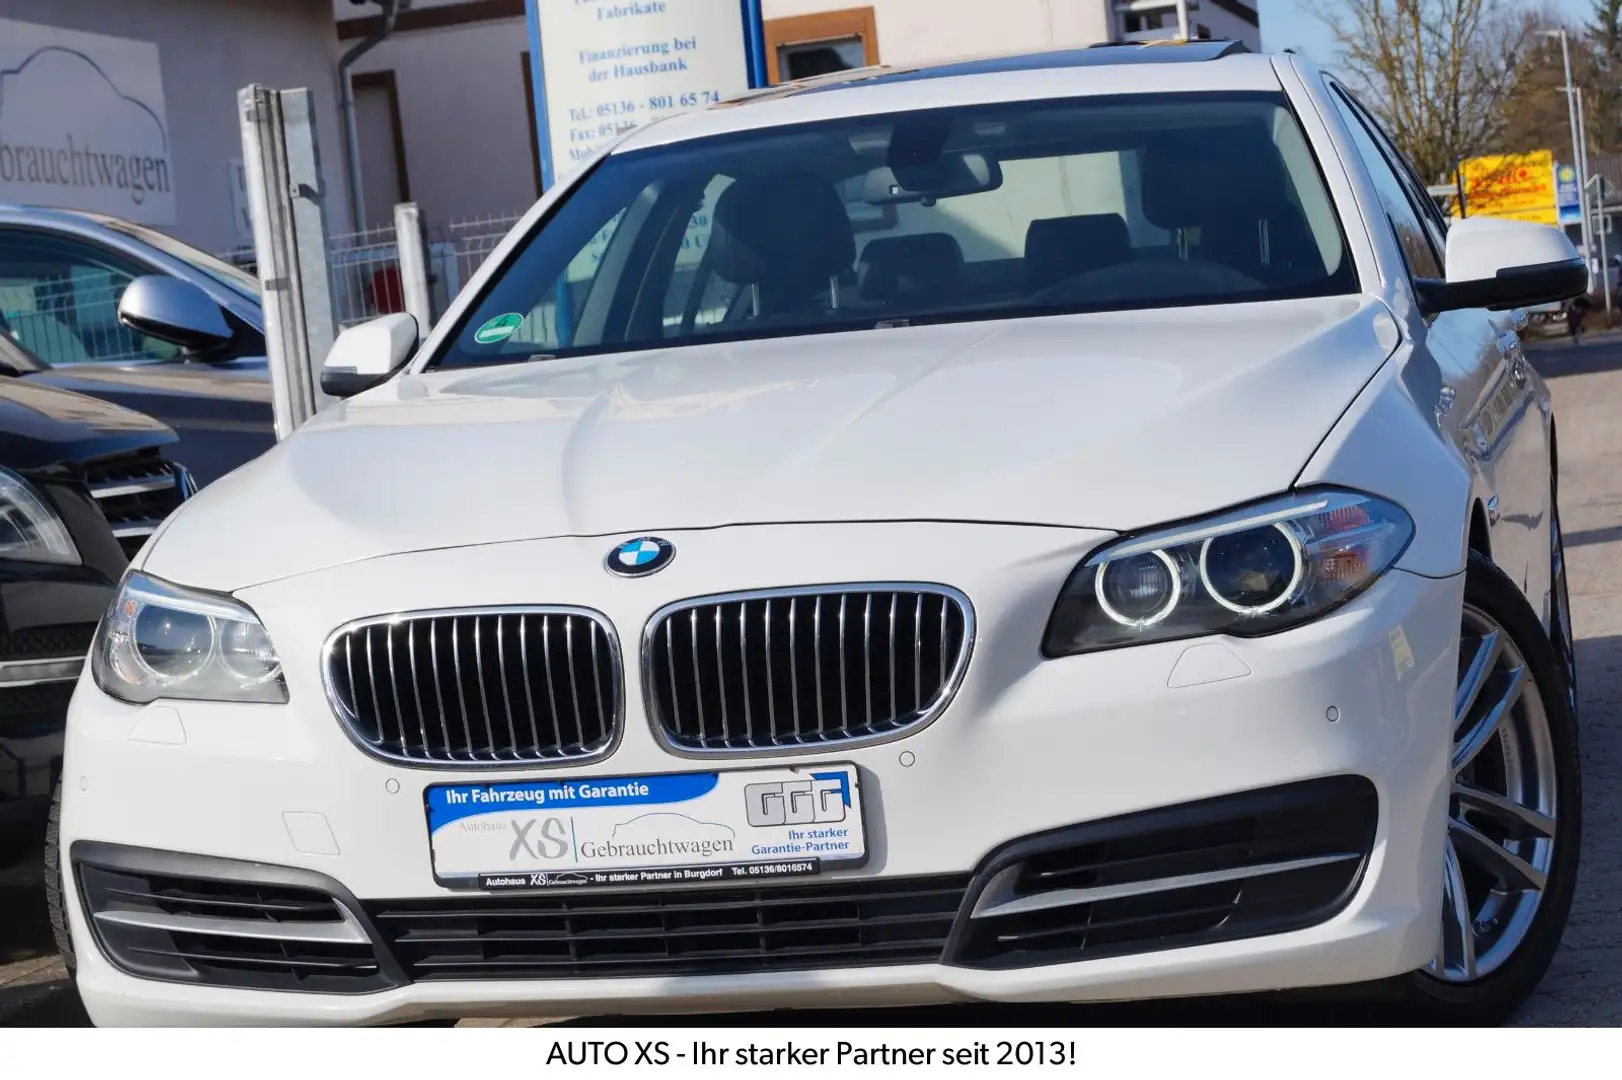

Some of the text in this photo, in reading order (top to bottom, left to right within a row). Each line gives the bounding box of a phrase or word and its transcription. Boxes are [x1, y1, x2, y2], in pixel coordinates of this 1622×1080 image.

[597, 1, 666, 20] Fabrikate
[578, 36, 697, 64] Finanzierung bei
[588, 57, 688, 82] der Hausbank
[596, 101, 635, 116] 05136
[649, 96, 673, 110] 801
[680, 92, 697, 107] 65
[702, 89, 720, 104] 74
[569, 128, 595, 142] Fax:
[446, 781, 649, 805] Ihr Fahrzeug mit Garantie
[459, 817, 734, 861] Autohaus XS Gebrauchtwagen
[788, 828, 848, 840] Ihr starker
[751, 840, 850, 856] Garantie-Partner
[486, 878, 527, 887] Autohaus
[595, 874, 607, 883] Ihr
[608, 872, 638, 882] starker
[640, 871, 672, 881] Partner
[674, 871, 683, 879] in
[684, 868, 724, 880] Burgdorf
[732, 867, 748, 876] Tel.
[749, 863, 813, 875] 05136/8016574
